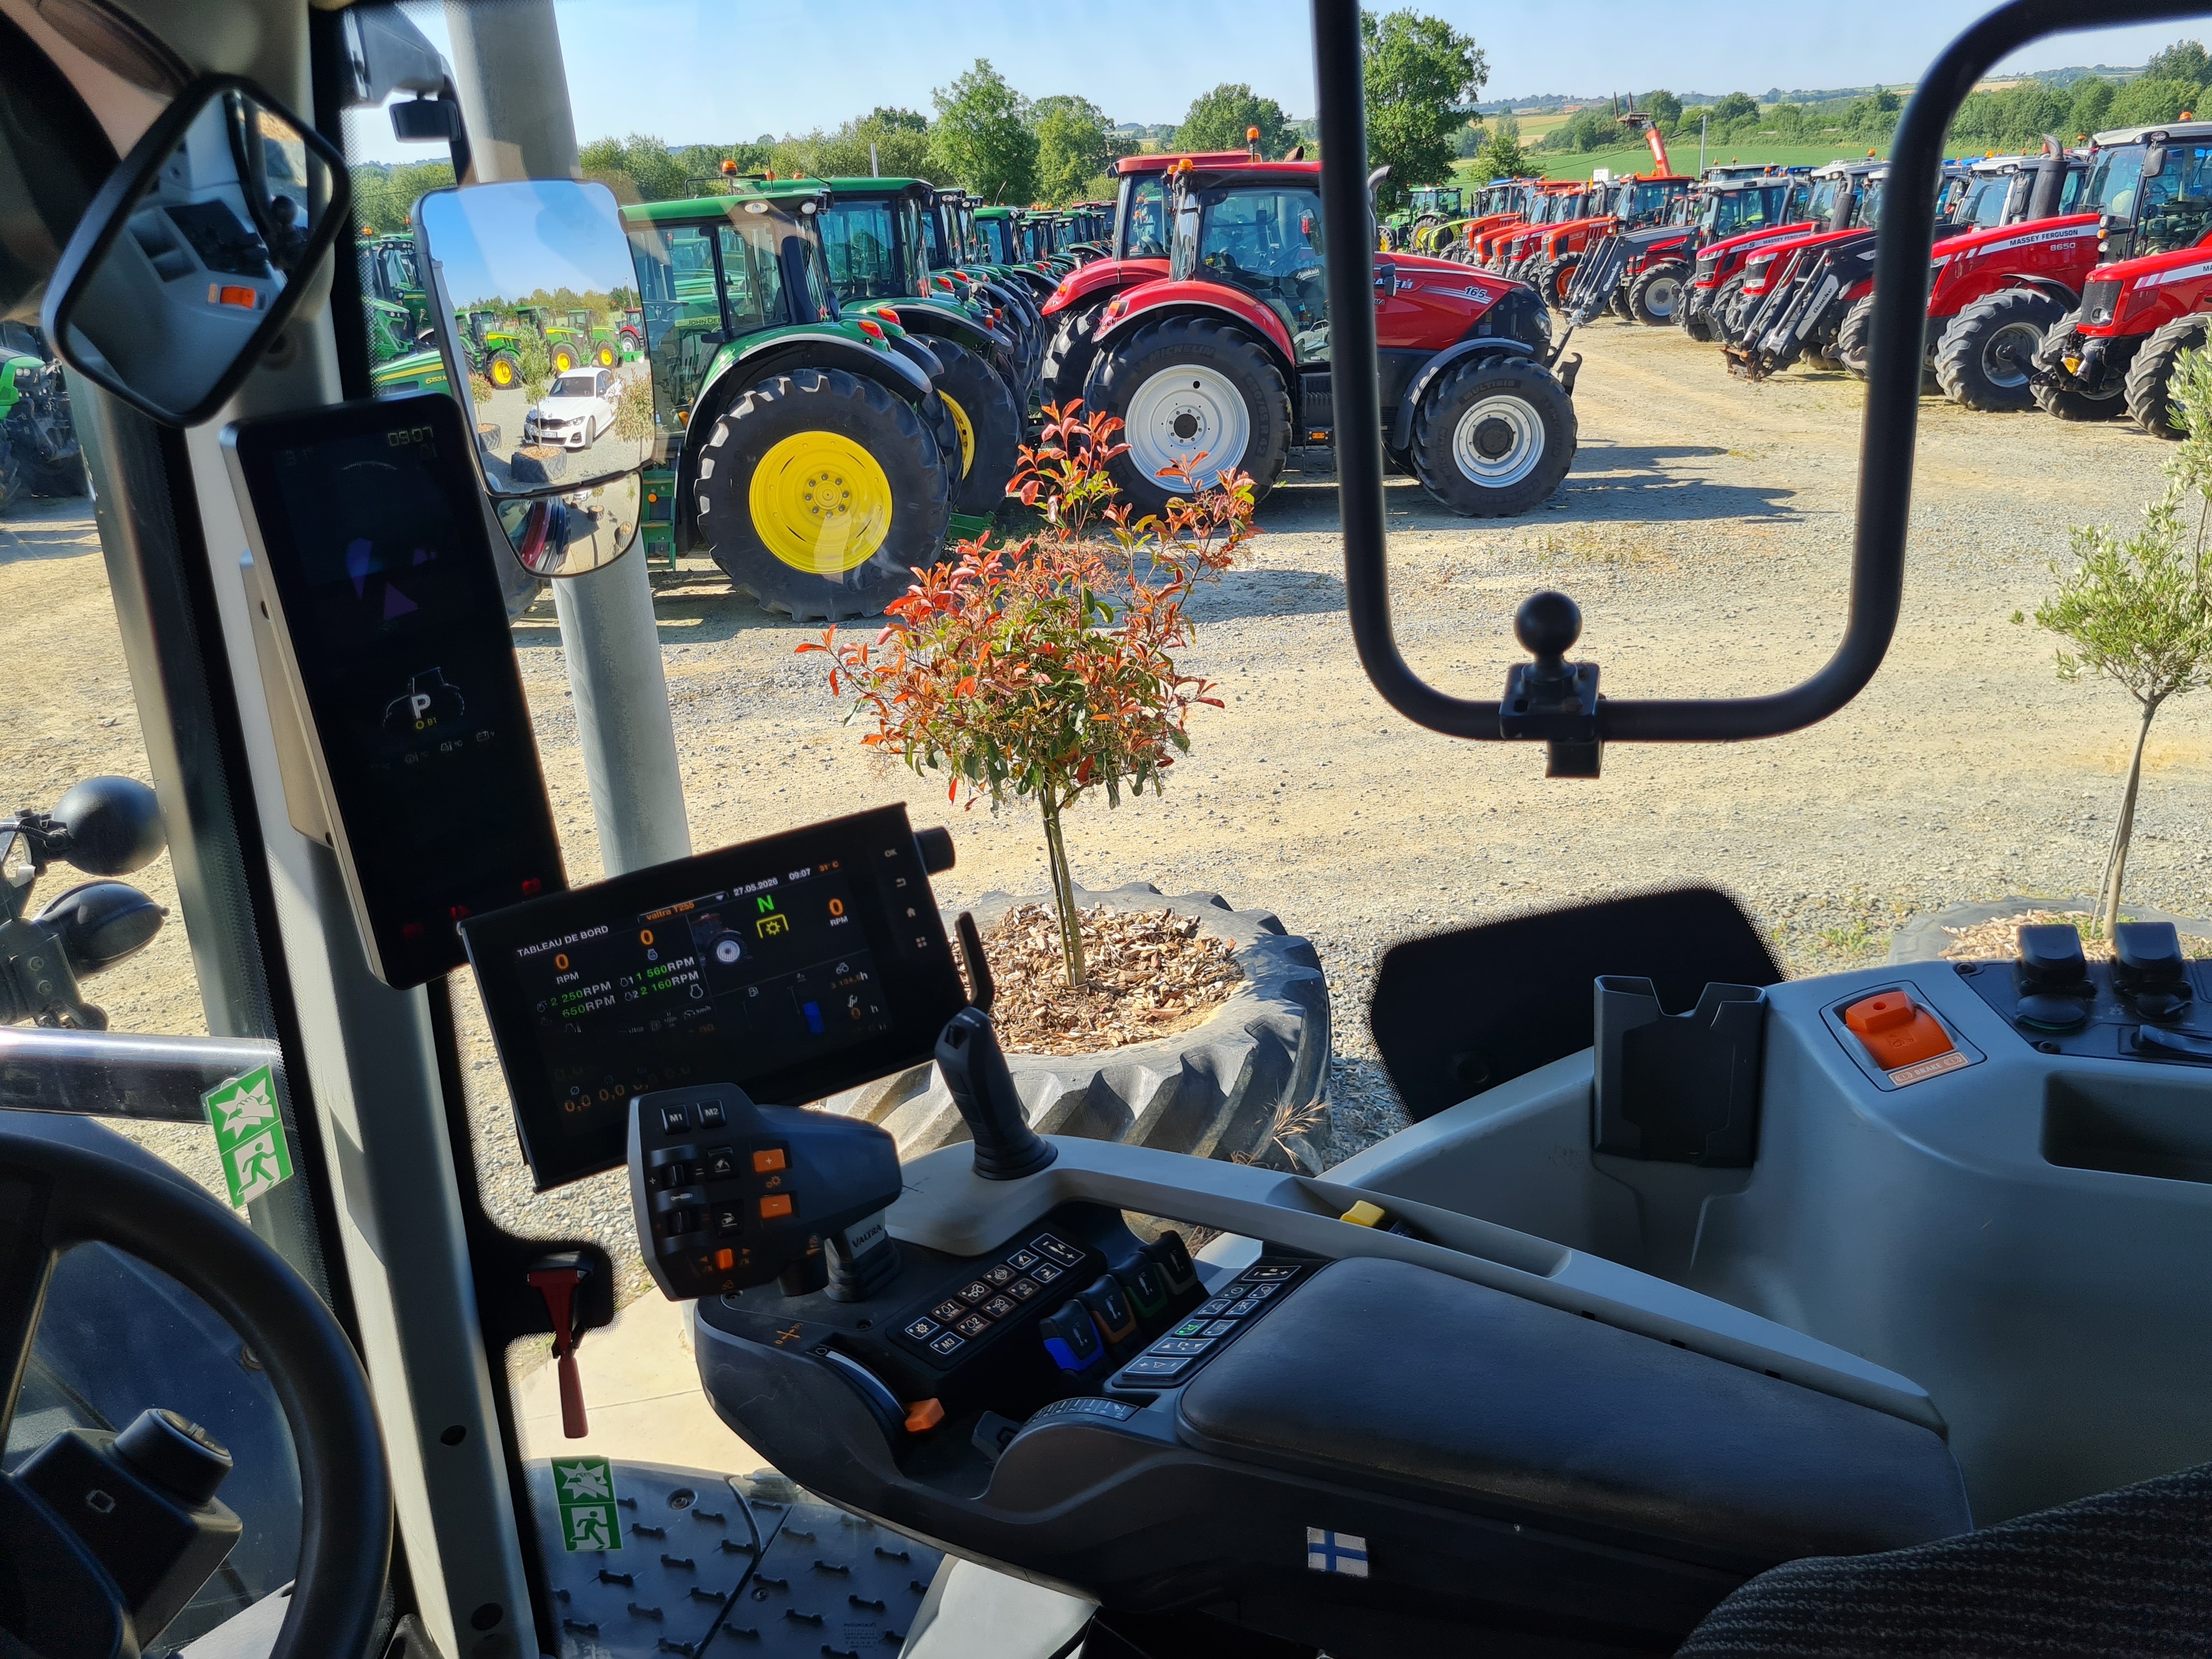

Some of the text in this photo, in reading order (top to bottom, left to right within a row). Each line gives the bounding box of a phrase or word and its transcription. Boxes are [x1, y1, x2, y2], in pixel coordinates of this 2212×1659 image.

[2010, 229, 2078, 246] MASSEY FERGUSON
[2050, 242, 2076, 251] 8650
[1464, 286, 1487, 298] 165
[1813, 287, 1833, 314] Quicke
[1149, 343, 1216, 361] MICHELIN
[412, 693, 431, 719] P
[884, 848, 898, 857] OK
[733, 877, 779, 897] 27.05.2026
[788, 867, 811, 881] 09:07
[756, 894, 776, 913] N
[828, 897, 845, 917] 0
[830, 915, 848, 927] RPM
[517, 925, 610, 958] TABLEAU DE BORD
[639, 928, 654, 946] 0
[554, 952, 570, 970] 0
[556, 972, 580, 985] RPM
[1914, 1063, 1943, 1075] BRAKE
[669, 1113, 683, 1122] M1
[704, 1108, 720, 1117] M2
[852, 1224, 882, 1248] VALTRA
[941, 1338, 955, 1349] M3
